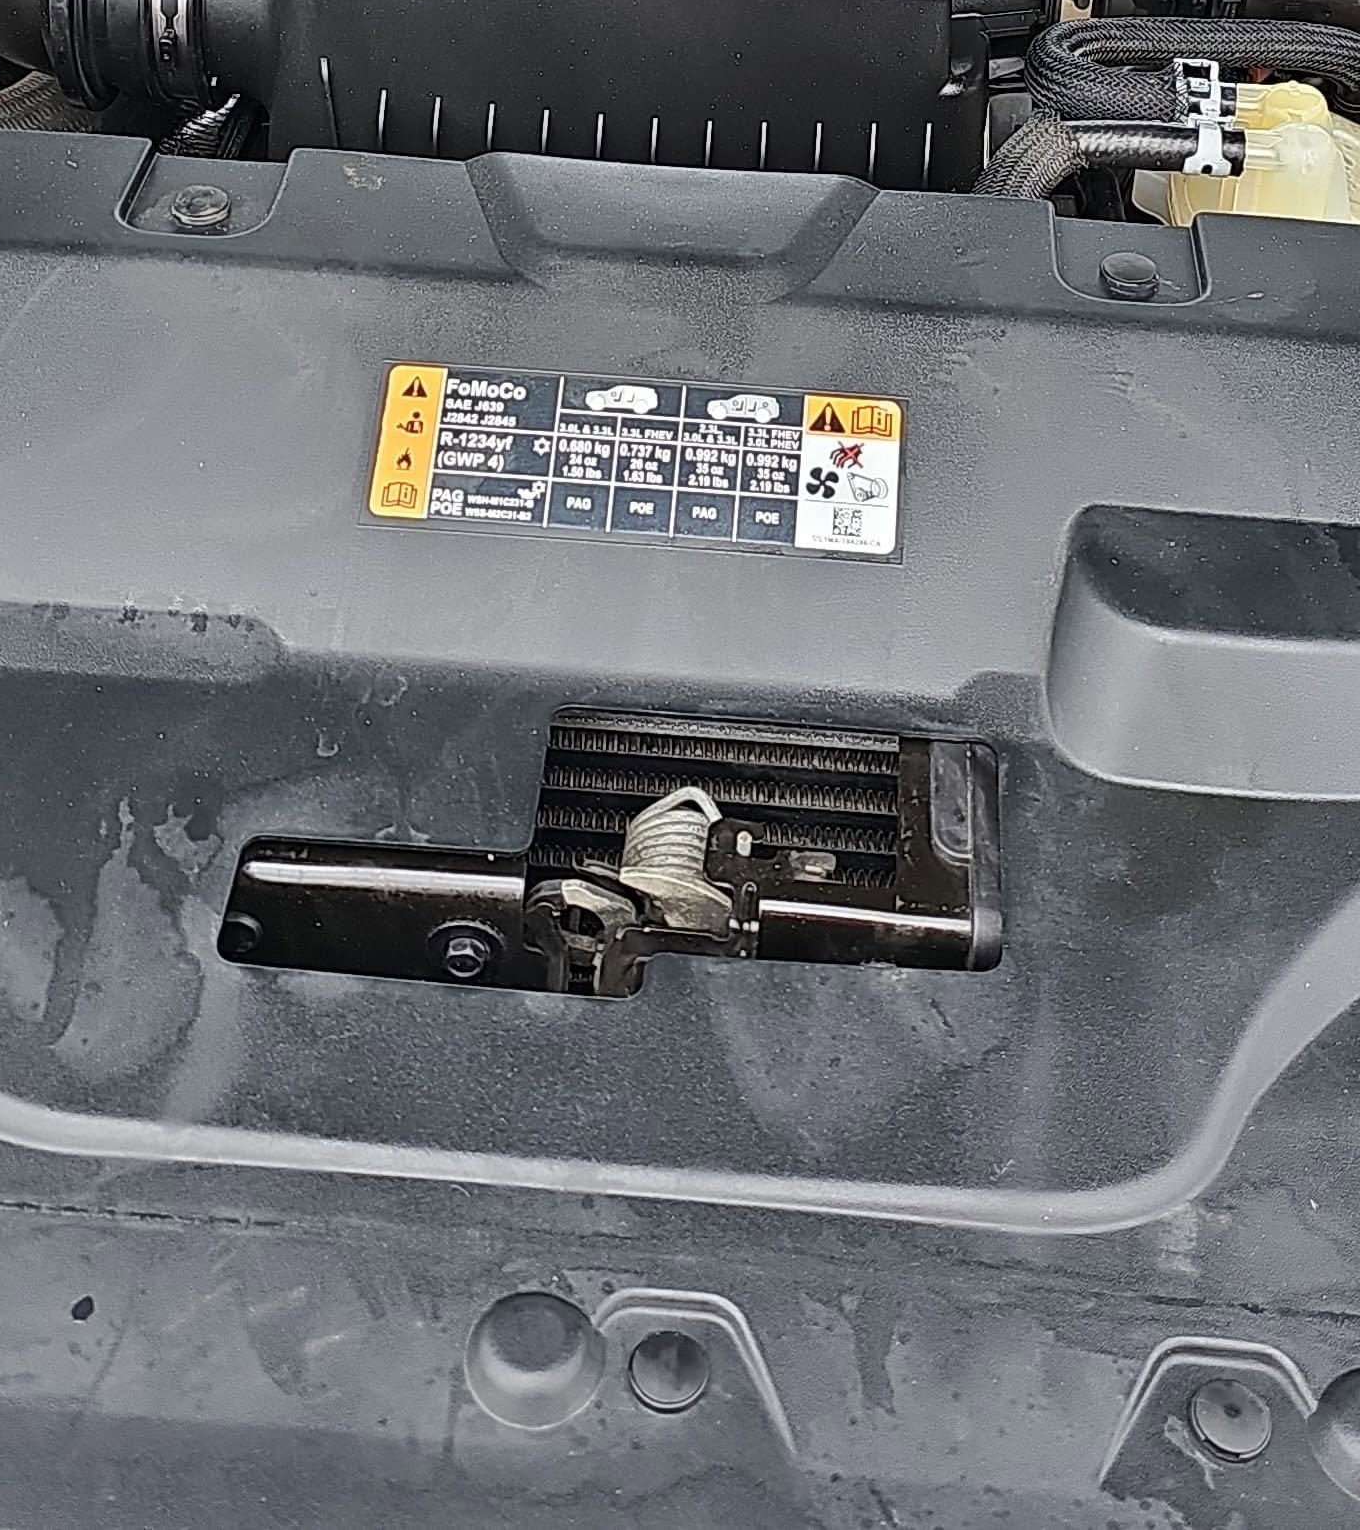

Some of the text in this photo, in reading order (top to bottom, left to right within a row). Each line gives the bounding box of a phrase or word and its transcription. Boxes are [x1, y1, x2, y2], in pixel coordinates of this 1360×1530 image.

[446, 378, 527, 401] FoMoCo
[445, 399, 505, 412] SAE J639
[443, 413, 517, 427] J2842 J2845
[621, 427, 674, 440] 3.3L FHEV
[683, 432, 705, 443] 3.0L
[717, 435, 738, 446] 3.3L
[747, 427, 801, 440] 3.3L FHEV
[440, 431, 513, 452] R-1234yf
[559, 438, 611, 458] 0.680 kg
[746, 437, 800, 450] 3.0L PHEV
[619, 443, 671, 462] 0.737 kg
[685, 448, 737, 467] 0.992 kg
[437, 450, 505, 472] (GWP 4)
[569, 454, 598, 467] 24 oz
[630, 459, 658, 471] 26 oz
[746, 453, 798, 473] 0.992 kg
[585, 467, 602, 479] lbs
[695, 463, 724, 476] 35 oz
[756, 468, 785, 481] 35 oz
[646, 472, 663, 484] lbs
[688, 474, 729, 489] 2.19 lbs
[749, 480, 790, 494] 2.19 lbs
[432, 488, 464, 503] PAG
[430, 501, 463, 516] POE
[566, 496, 592, 510] PAG
[629, 501, 655, 514] POE
[692, 506, 717, 520] PAG
[755, 511, 780, 525] POE
